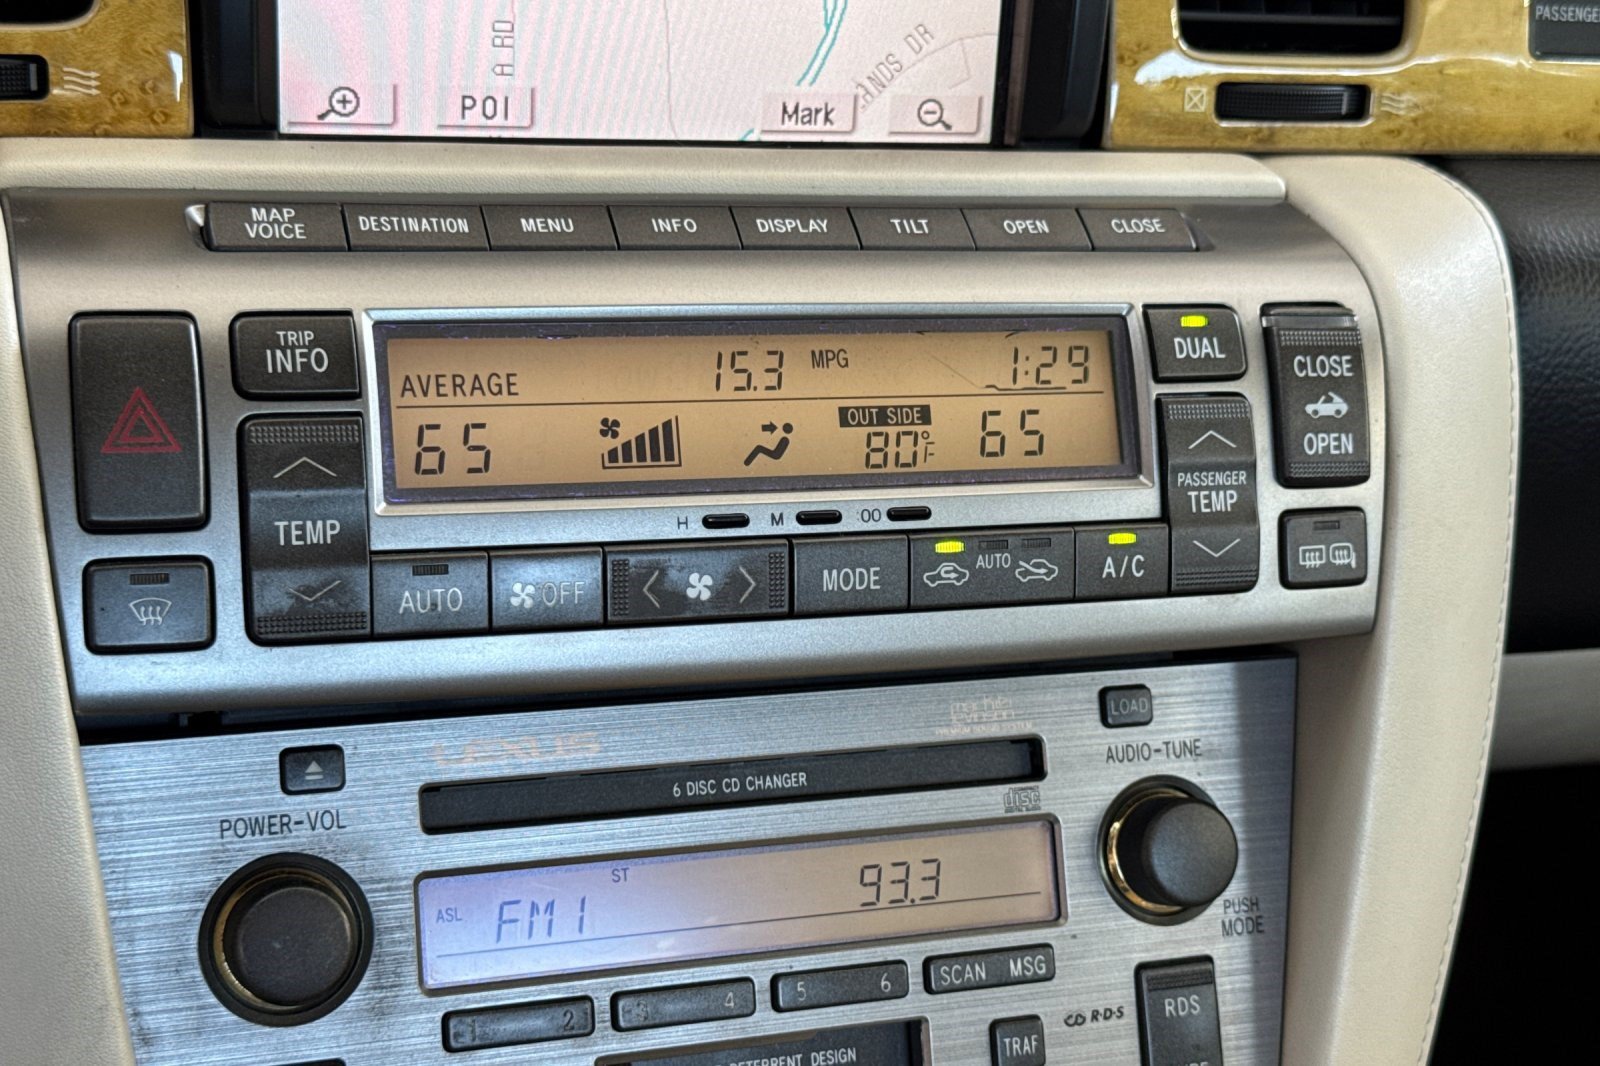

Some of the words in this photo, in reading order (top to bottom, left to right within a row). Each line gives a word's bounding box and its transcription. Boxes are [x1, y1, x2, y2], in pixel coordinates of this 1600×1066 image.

[1535, 4, 1600, 22] PASSENGE
[491, 20, 515, 48] RD
[904, 24, 934, 54] DR
[461, 95, 509, 121] POI
[781, 101, 835, 126] Mark
[251, 207, 296, 222] MAP
[358, 216, 470, 233] DESTINATION
[520, 217, 575, 233] MENU
[651, 218, 698, 233] INFO
[245, 223, 307, 239] VOICE
[755, 218, 829, 234] DISPLAY
[890, 219, 929, 234] TILT
[1003, 220, 1050, 235] OPEN
[1111, 218, 1167, 234] CLOSE
[276, 330, 315, 346] TRIP
[1174, 337, 1226, 359] DUAL
[266, 348, 329, 373] INFO
[715, 350, 784, 392] 15.3
[811, 349, 849, 369] MPG
[1012, 345, 1090, 386] 1:29
[1293, 355, 1353, 378] CLOSE
[400, 373, 519, 398] AVERAGE
[847, 408, 878, 426] OUT
[886, 407, 923, 425] SIDE
[979, 408, 1044, 458] 65
[1303, 433, 1353, 455] OPEN
[414, 422, 491, 476] 65
[1177, 470, 1247, 487] PASSENGER
[1187, 491, 1238, 513] TEMP
[677, 516, 689, 530] H
[770, 512, 784, 526] M
[274, 519, 341, 546] TEMP
[976, 553, 1011, 569] AUTO
[1102, 555, 1145, 578] A/C
[823, 567, 881, 592] MODE
[399, 587, 463, 614] AUTO
[542, 581, 585, 607] OFF
[1110, 697, 1149, 716] LOAD
[1105, 738, 1202, 764] AUDIO-TUNE
[672, 782, 682, 798] 6
[686, 779, 717, 797] DISC
[722, 777, 741, 793] CD
[745, 771, 808, 791] CHANGER
[220, 809, 346, 839] POWER-VOL
[611, 868, 630, 883] ST
[860, 858, 941, 907] 93.3
[436, 907, 463, 924] ASL
[1223, 897, 1259, 915] PUSH
[1221, 915, 1265, 937] MODE
[939, 961, 986, 987] SCAN
[1009, 955, 1047, 977] MSG
[797, 981, 807, 1001] 5
[880, 973, 892, 994] 6
[724, 991, 735, 1009] 4
[1164, 995, 1201, 1018] RDS
[562, 1009, 576, 1031] 2
[810, 1047, 857, 1066] DESIGN
[1003, 1035, 1038, 1057] TRAF
